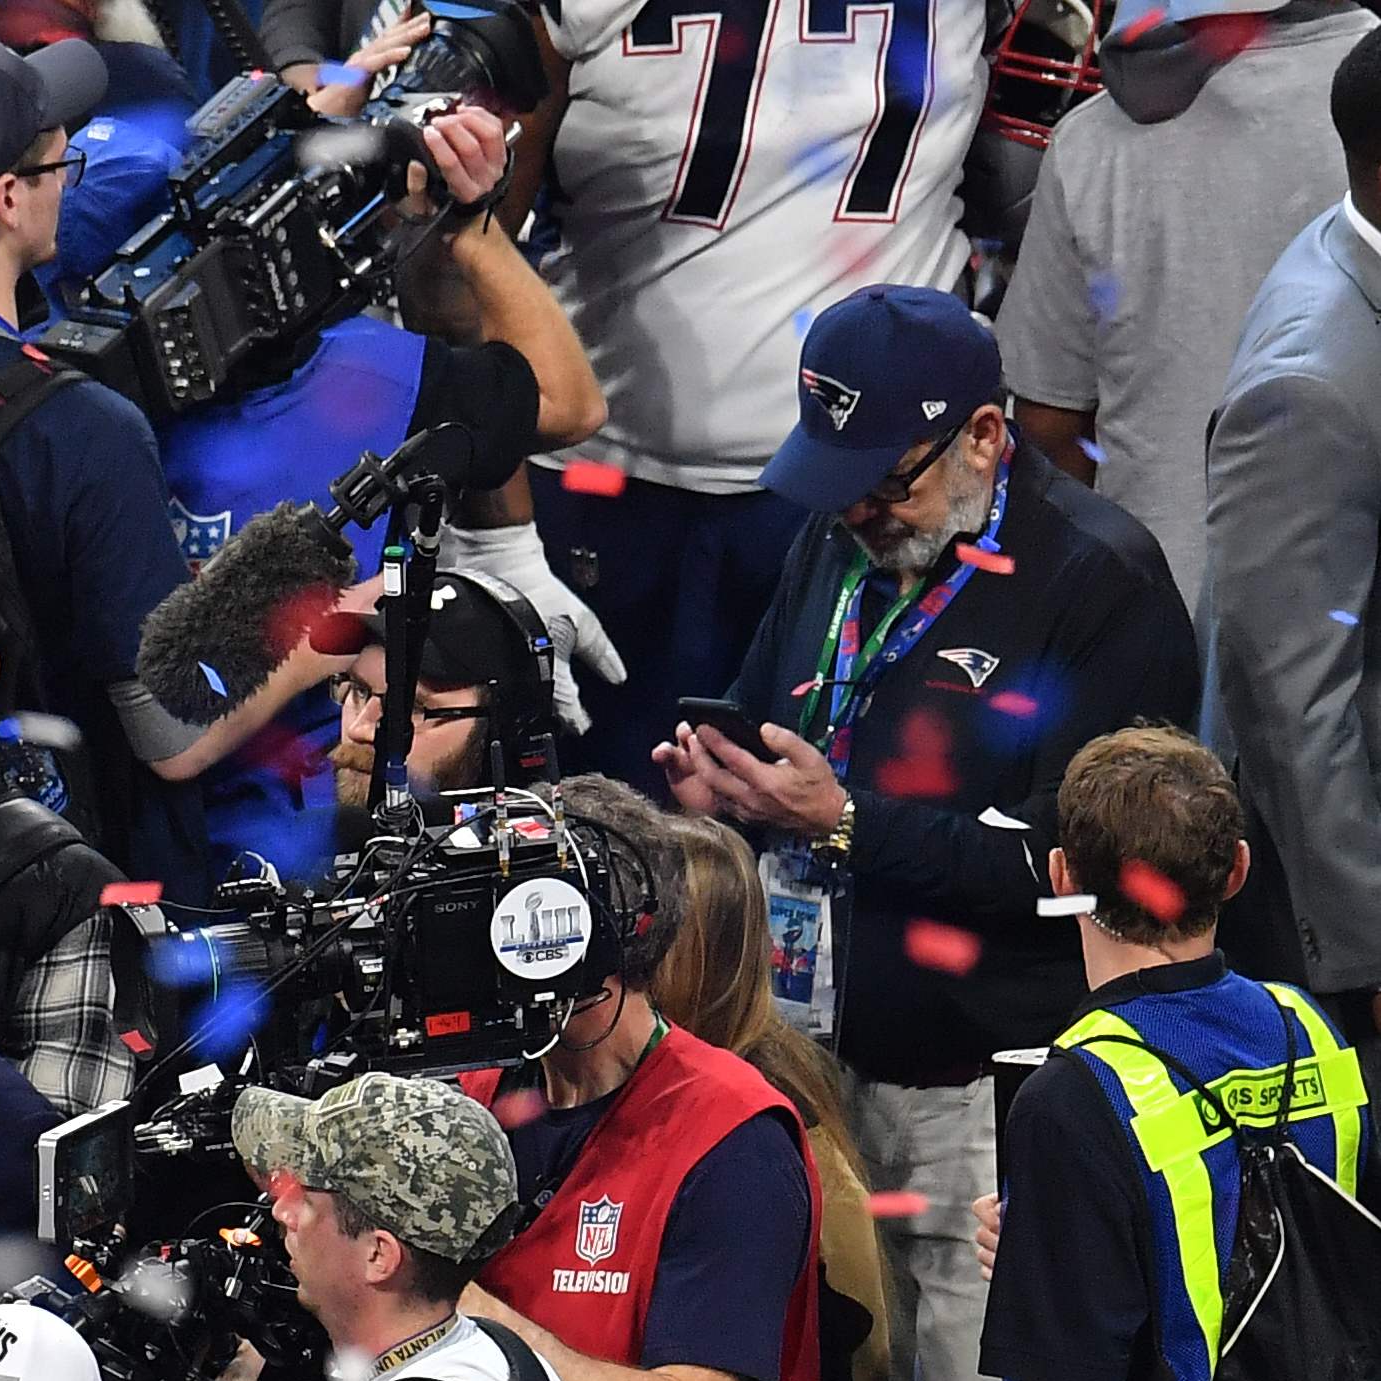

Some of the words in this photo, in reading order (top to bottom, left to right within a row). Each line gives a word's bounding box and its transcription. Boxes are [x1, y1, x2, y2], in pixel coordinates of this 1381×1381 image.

[622, 0, 943, 231] 77
[433, 899, 480, 914] SONY
[535, 948, 565, 962] CBS
